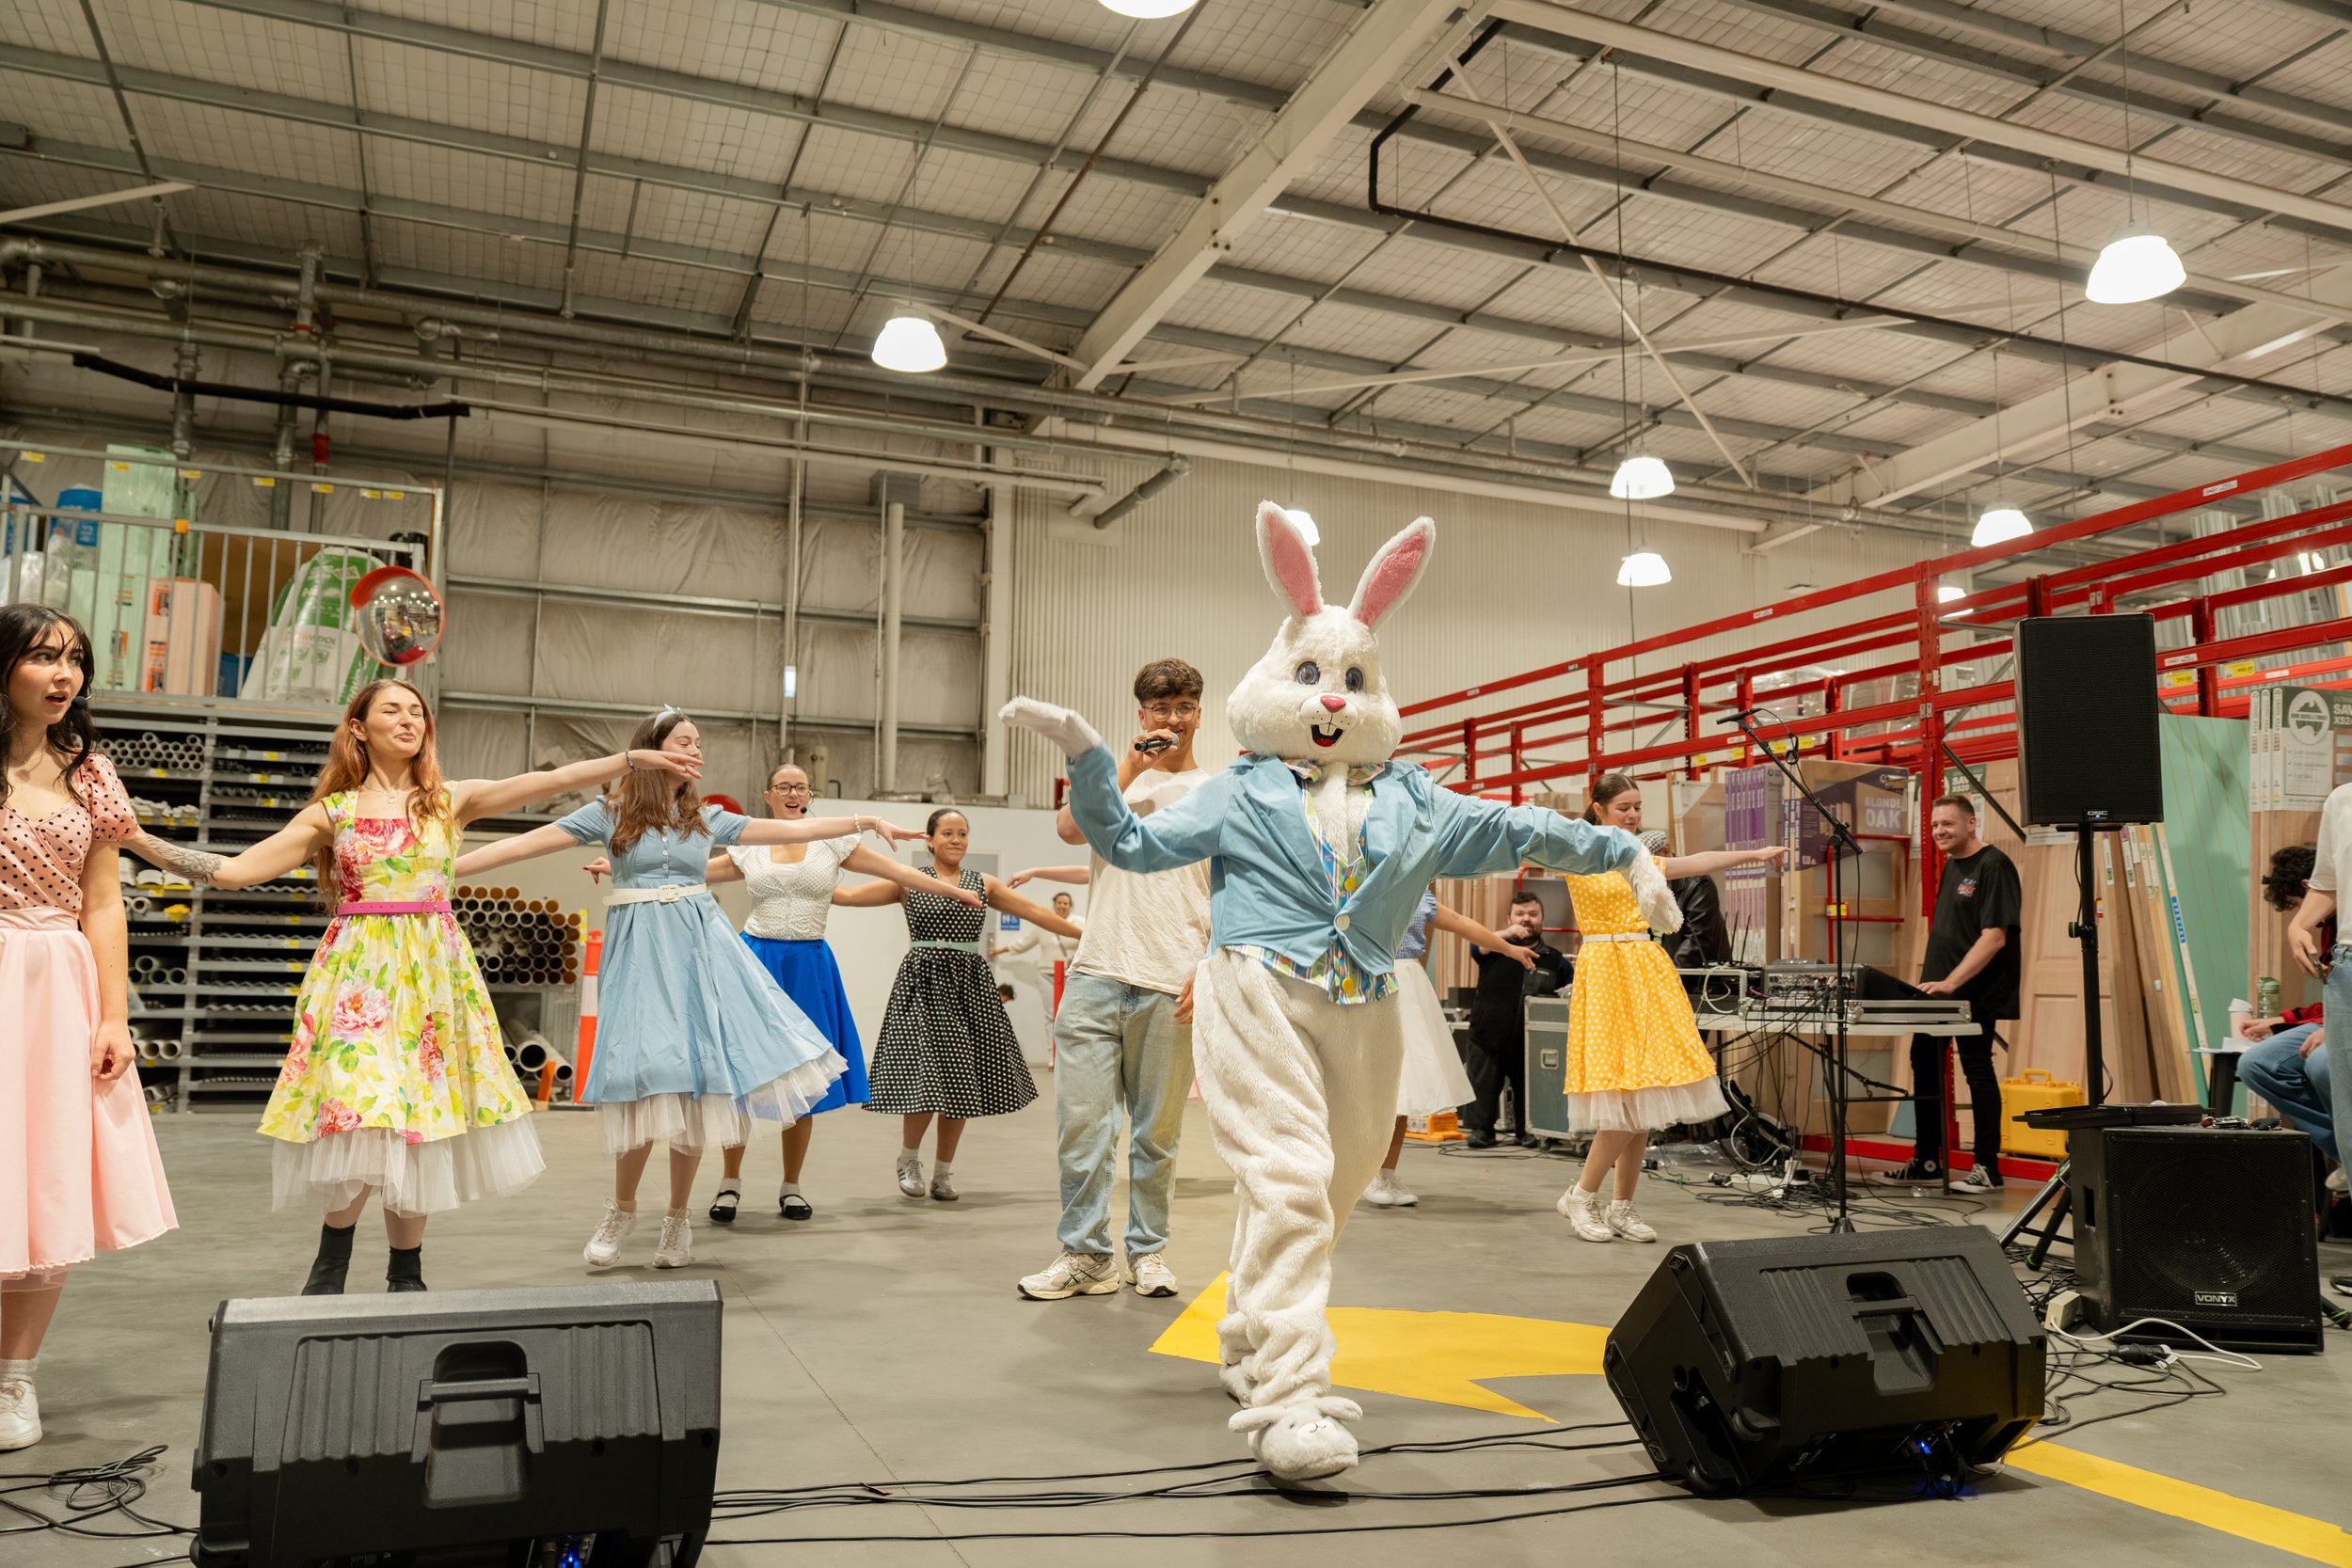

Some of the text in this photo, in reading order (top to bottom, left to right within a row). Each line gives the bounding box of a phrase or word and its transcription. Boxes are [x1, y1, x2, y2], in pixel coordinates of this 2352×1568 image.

[1951, 773, 1983, 786] SAVY
[1865, 797, 1902, 809] BLONDE
[1865, 808, 1901, 829] OAK
[2197, 1294, 2236, 1303] VONYX
